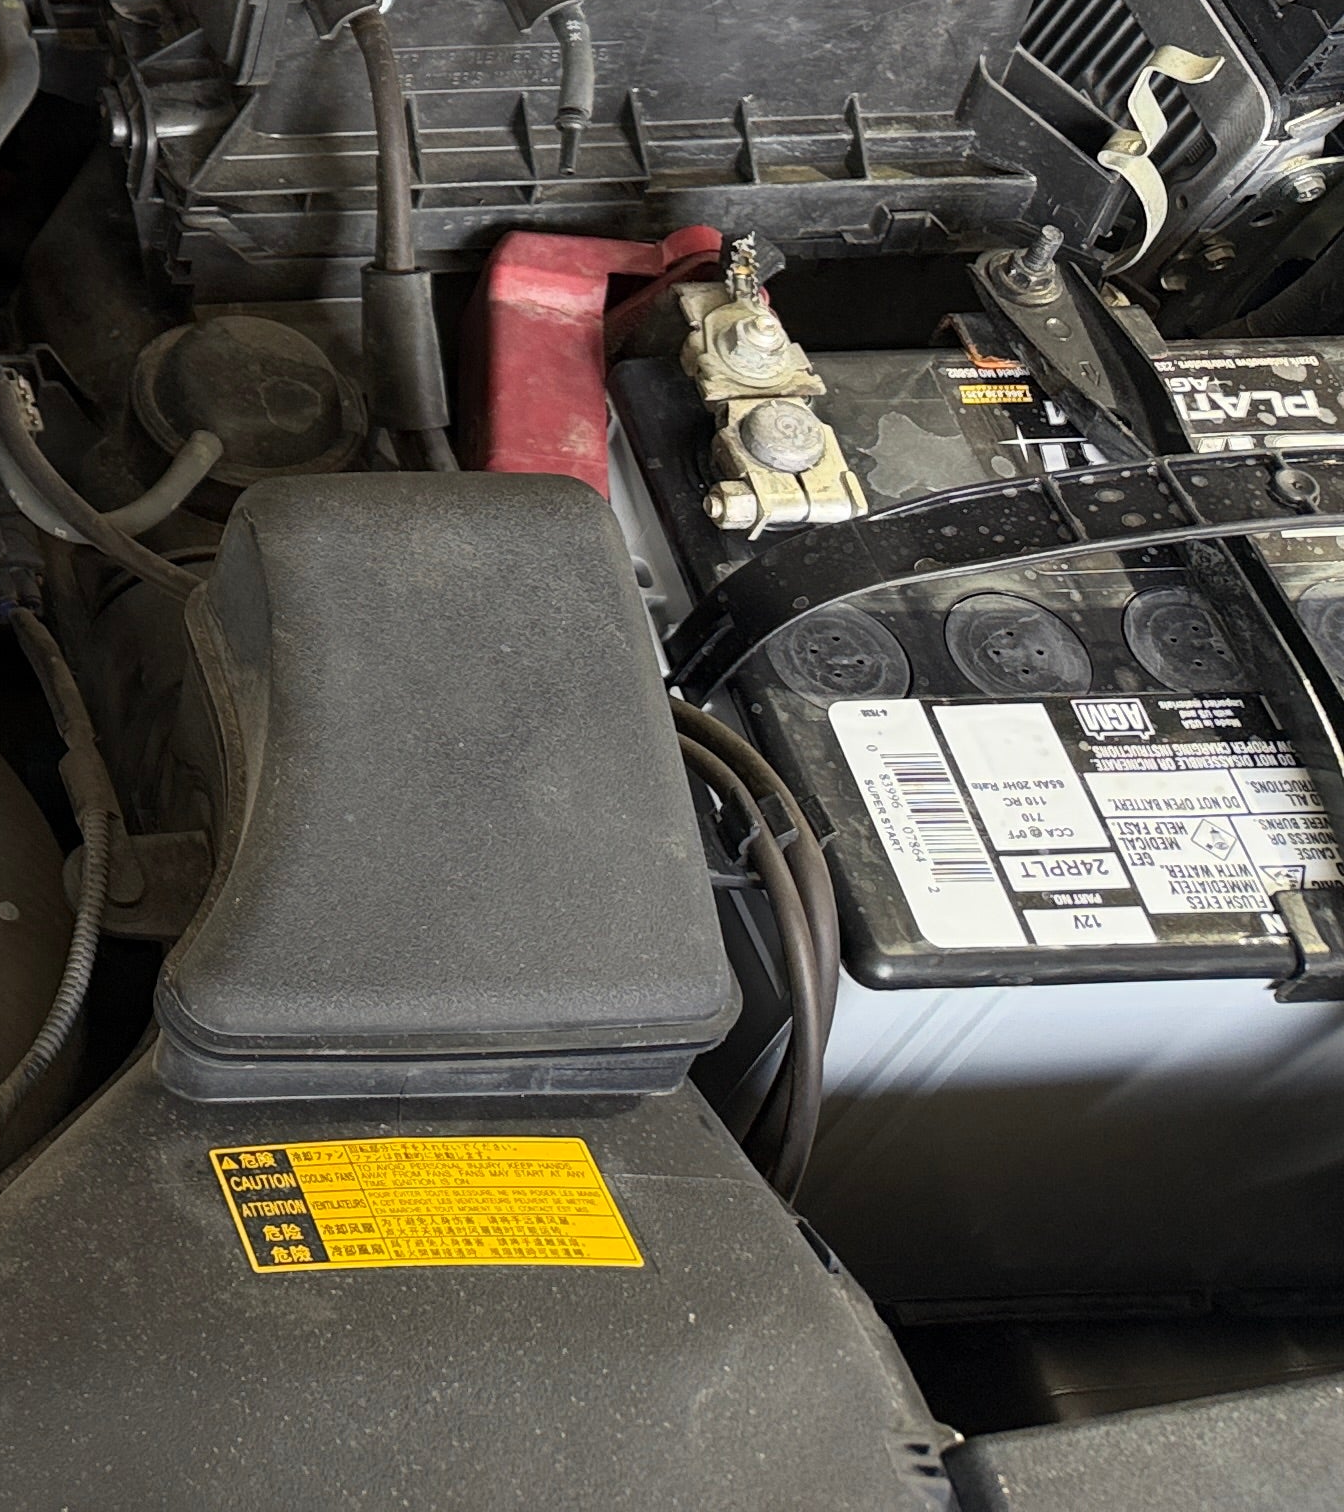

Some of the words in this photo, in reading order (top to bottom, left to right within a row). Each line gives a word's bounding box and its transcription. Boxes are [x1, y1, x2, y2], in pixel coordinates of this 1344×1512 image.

[1077, 702, 1145, 731] AGM
[1172, 741, 1231, 756] CHARGING
[1230, 741, 1278, 755] PROPER
[1089, 757, 1158, 772] INCINERATE.
[1156, 757, 1177, 771] OR
[1175, 755, 1255, 770] DISASSEMBLE
[1253, 754, 1278, 767] NOT
[1277, 753, 1297, 767] DO
[970, 782, 1000, 792] Rate
[1003, 780, 1030, 791] 20Hr
[1033, 779, 1065, 790] 65Ah
[1002, 796, 1023, 807] RC
[1025, 796, 1047, 807] 110
[1107, 798, 1162, 812] BATTERY.
[1163, 797, 1195, 811] OPEN
[1196, 796, 1220, 810] NOT
[1222, 795, 1241, 809] DO
[1284, 793, 1308, 806] ALL
[863, 779, 886, 815] SUPER
[880, 818, 905, 854] START
[1021, 813, 1045, 823] 710
[1253, 817, 1301, 830] BURNS.
[1044, 827, 1075, 838] CCA
[1110, 821, 1152, 836] FAST.
[1154, 821, 1189, 836] HELP
[1118, 836, 1183, 852] MEDICAL
[1266, 832, 1287, 846] OR
[1127, 852, 1156, 867] GET
[1294, 847, 1335, 861] CAUSE
[1020, 858, 1110, 878] 24RPLT
[1159, 864, 1215, 879] WATER.
[1214, 864, 1254, 878] WITH
[1168, 879, 1261, 895] IMMEDIATELY
[1050, 893, 1074, 906] NO.
[1072, 892, 1103, 905] PART
[1185, 895, 1220, 910] EYES
[1223, 894, 1268, 909] FLUSH
[1072, 914, 1102, 930] 12V
[358, 1163, 371, 1172] TO
[377, 1162, 405, 1171] AVOID
[391, 1170, 421, 1179] FROM
[489, 1169, 509, 1178] MAY
[230, 1172, 297, 1192] CAUTION
[299, 1172, 333, 1184] COOLING
[334, 1171, 356, 1183] FANS
[241, 1199, 307, 1218] ATTENTION
